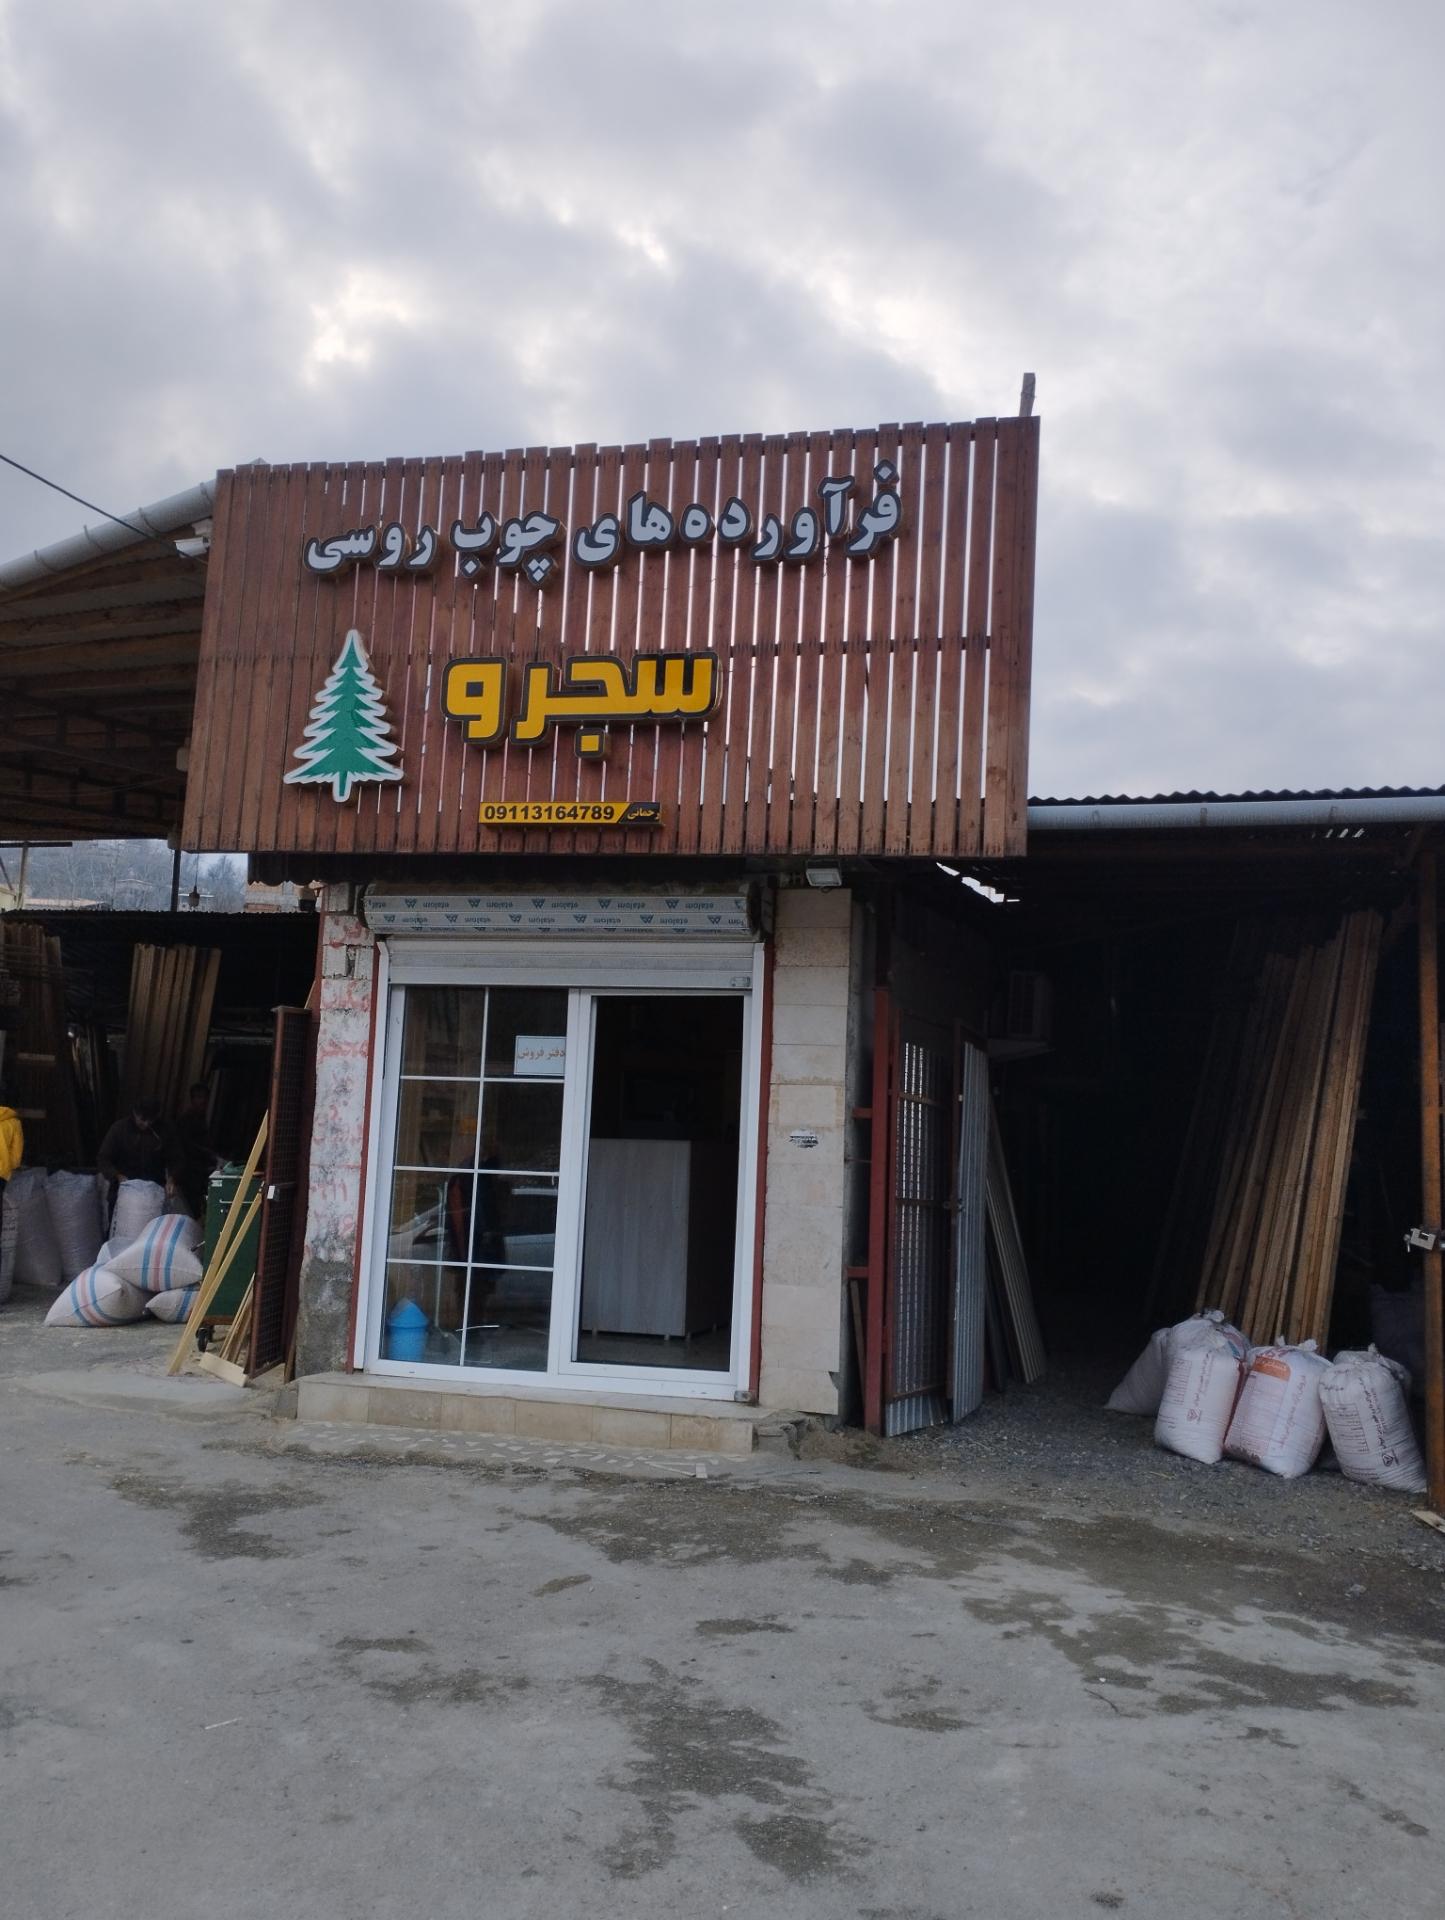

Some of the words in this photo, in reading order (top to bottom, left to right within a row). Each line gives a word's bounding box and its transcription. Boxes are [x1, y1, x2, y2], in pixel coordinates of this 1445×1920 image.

[304, 522, 437, 576] روسی
[450, 511, 562, 585] چوب
[441, 651, 720, 759] سجرو
[484, 805, 615, 821] 09113164789
[516, 1046, 545, 1060] فروش
